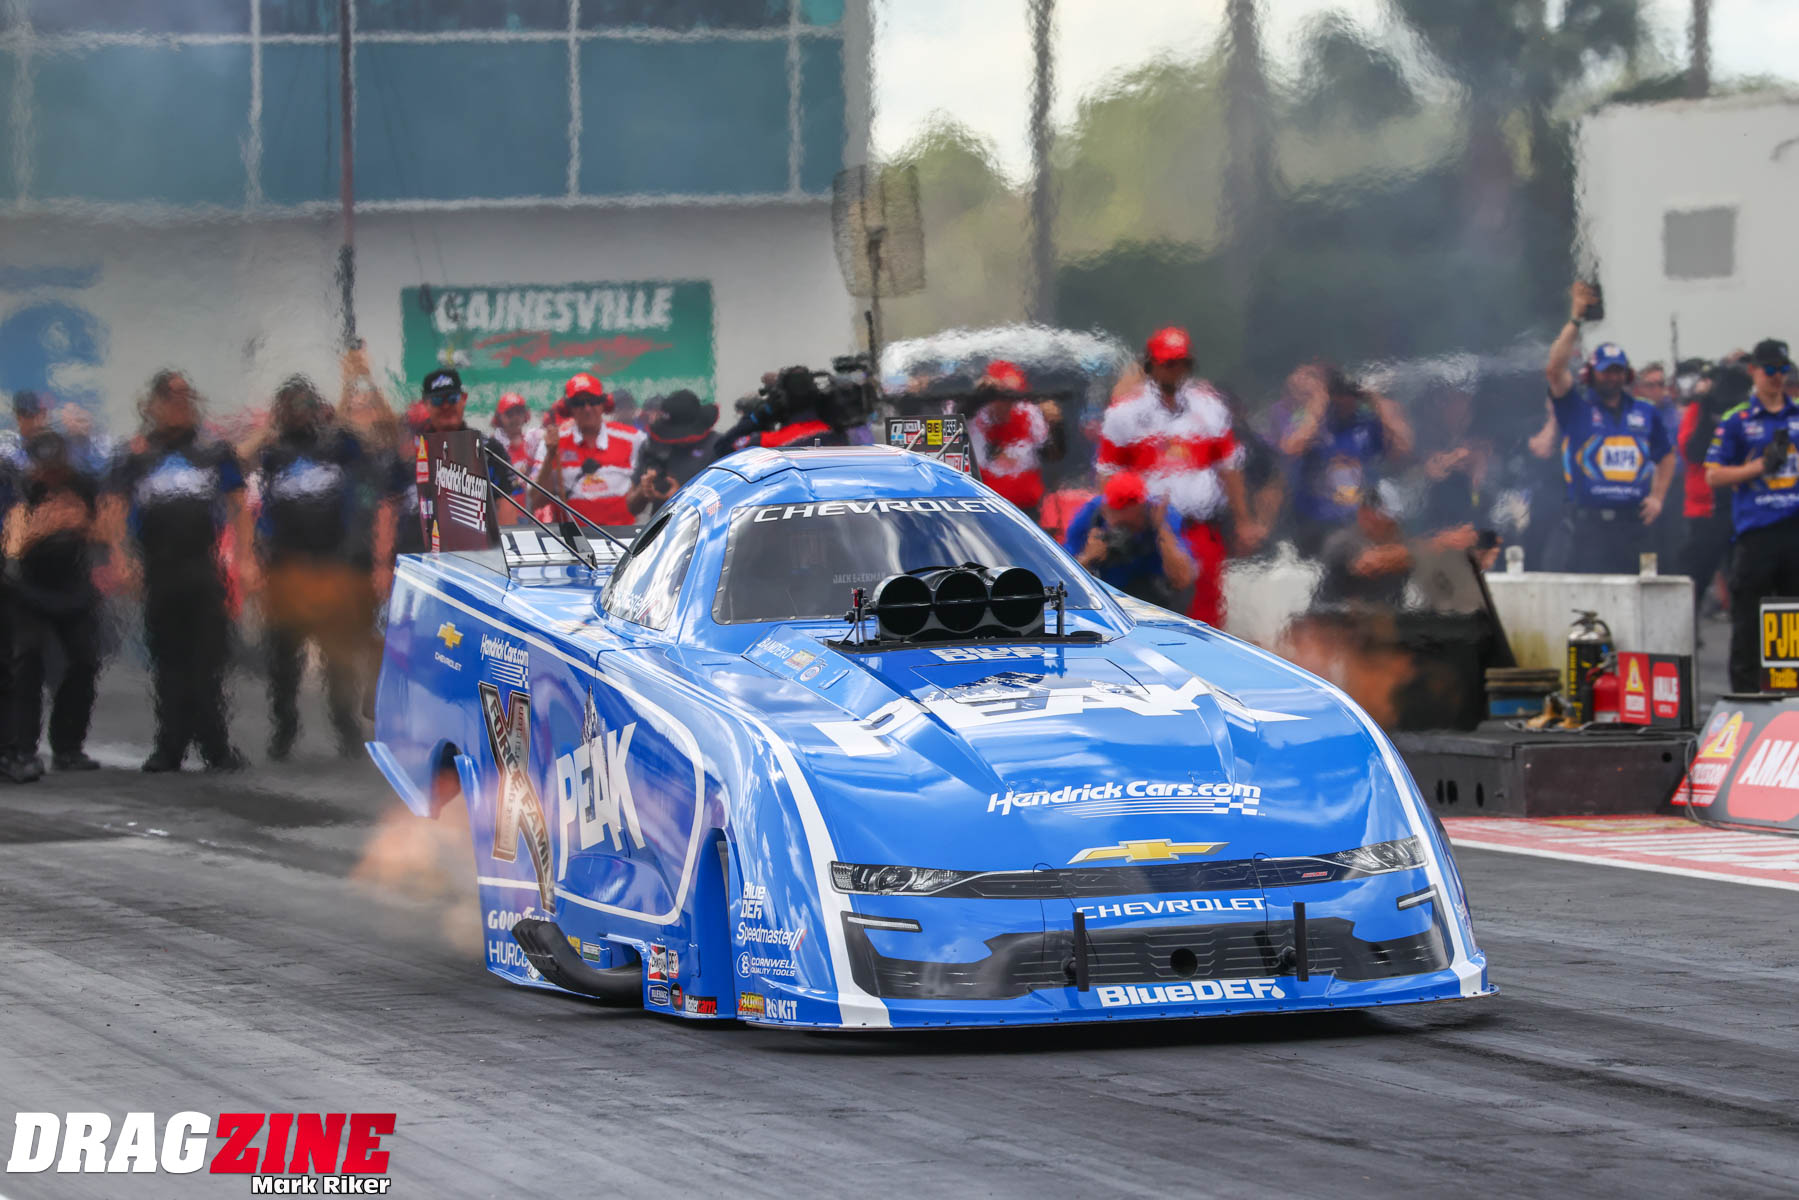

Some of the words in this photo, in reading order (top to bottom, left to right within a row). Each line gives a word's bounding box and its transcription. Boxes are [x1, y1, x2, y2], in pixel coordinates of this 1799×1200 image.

[435, 286, 675, 333] GAINESVILLE
[753, 497, 1003, 523] CHEVROLET
[556, 721, 647, 882] PEAK
[521, 792, 553, 893] FAMI
[743, 881, 767, 900] Blue
[740, 900, 764, 919] DEF
[1076, 897, 1266, 920] CHEVROLET
[736, 921, 794, 945] Speedmaster
[750, 966, 771, 976] QUALITY
[772, 968, 796, 977] TOOLS
[751, 957, 797, 969] CORNWELL
[1096, 979, 1277, 1008] BlueDEF
